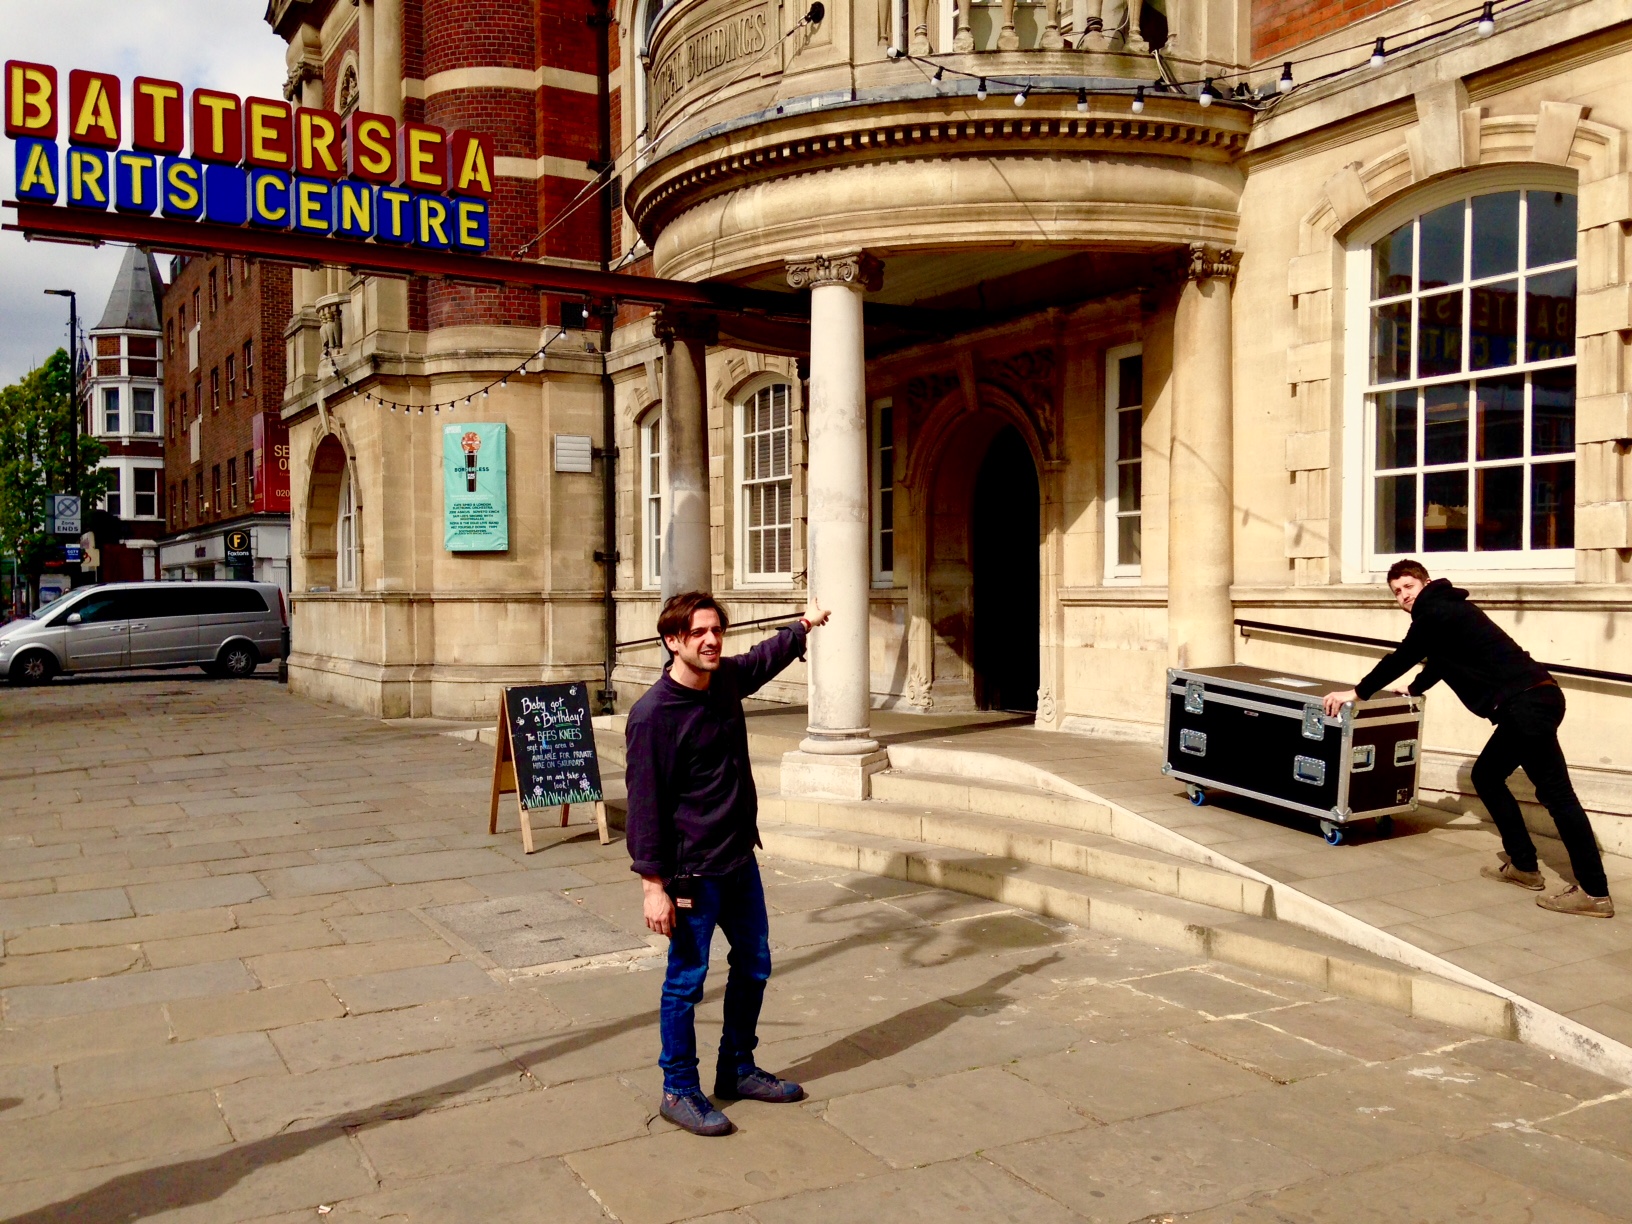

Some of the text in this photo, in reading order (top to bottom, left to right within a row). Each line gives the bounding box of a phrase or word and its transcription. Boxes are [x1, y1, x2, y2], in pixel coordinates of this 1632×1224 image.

[686, 11, 766, 83] BUILDINGS
[11, 66, 492, 193] BATTERSEA
[20, 143, 485, 247] ARTS CENTRE
[274, 444, 291, 457] SE
[233, 534, 242, 548] F
[521, 696, 565, 715] Baby got
[541, 708, 585, 728] Birthday?
[525, 728, 582, 742] The BEES KNEES
[526, 743, 539, 754] soft
[531, 750, 593, 762] AVAILABLE FOR PRIVATE
[532, 761, 545, 769] HIRE
[557, 759, 585, 768] SATURDAYS
[532, 774, 544, 783] Pop
[555, 771, 565, 780] and
[566, 770, 580, 780] take
[553, 779, 570, 790] look!
